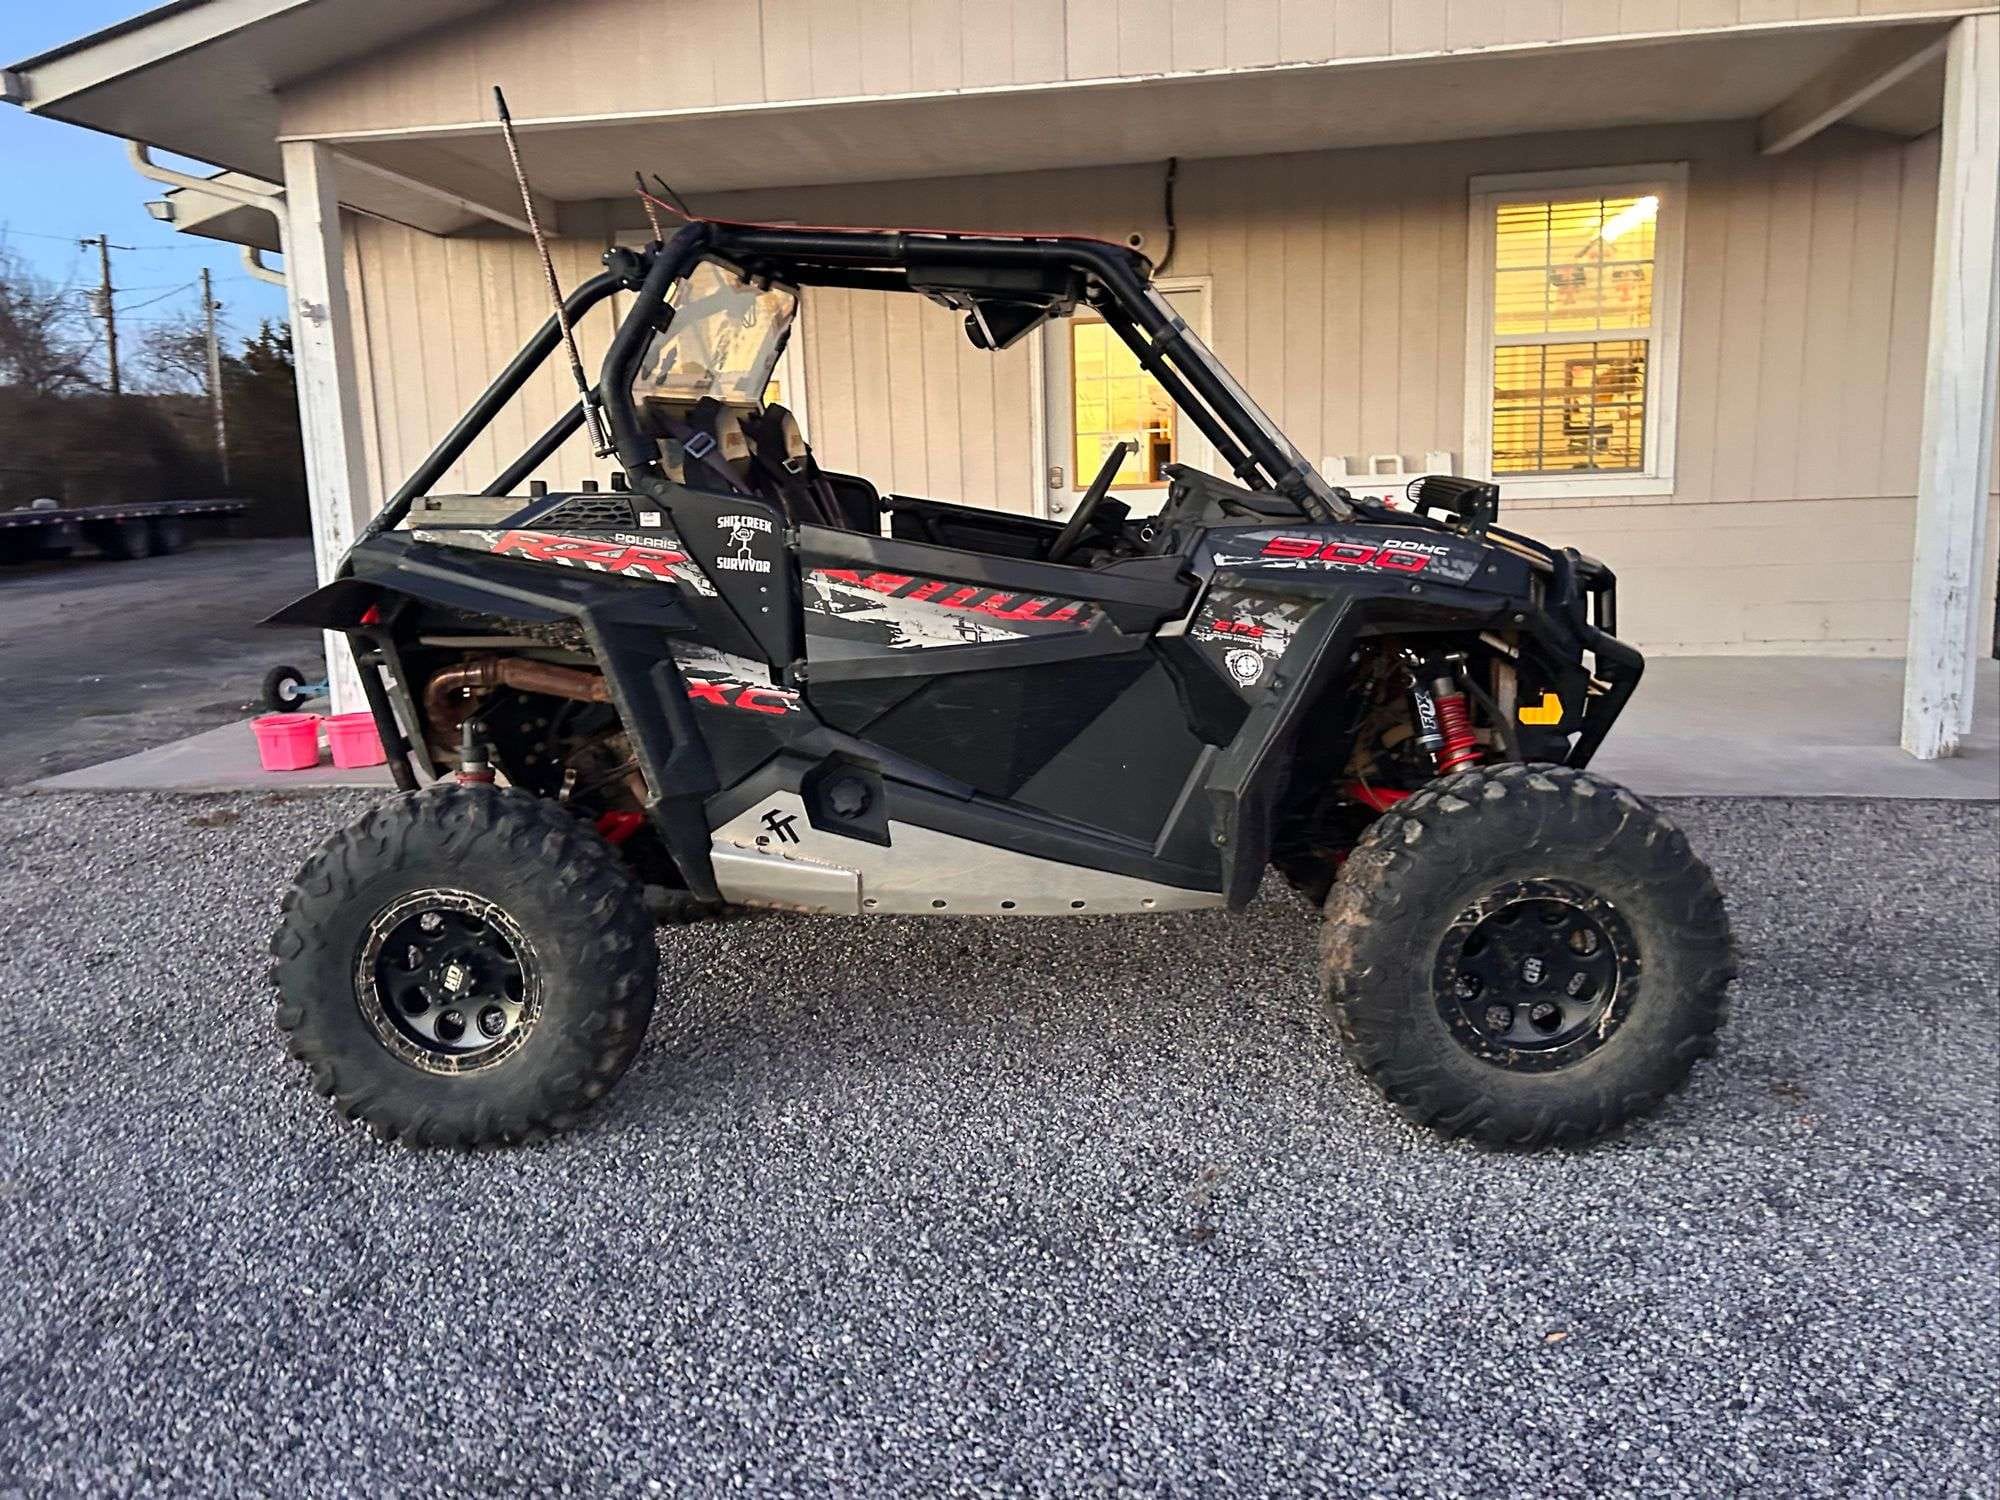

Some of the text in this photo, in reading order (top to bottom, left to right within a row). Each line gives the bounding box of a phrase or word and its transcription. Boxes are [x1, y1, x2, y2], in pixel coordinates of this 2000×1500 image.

[741, 516, 772, 533] CREEK
[615, 533, 678, 550] POLARIS
[1383, 539, 1450, 556] DOHC
[490, 530, 688, 577] RZR
[1259, 536, 1431, 573] 900
[717, 557, 771, 573] SURVIVOR
[1211, 619, 1265, 637] EPS
[686, 677, 800, 715] XC
[1414, 691, 1437, 729] FOX
[444, 965, 460, 992] HD
